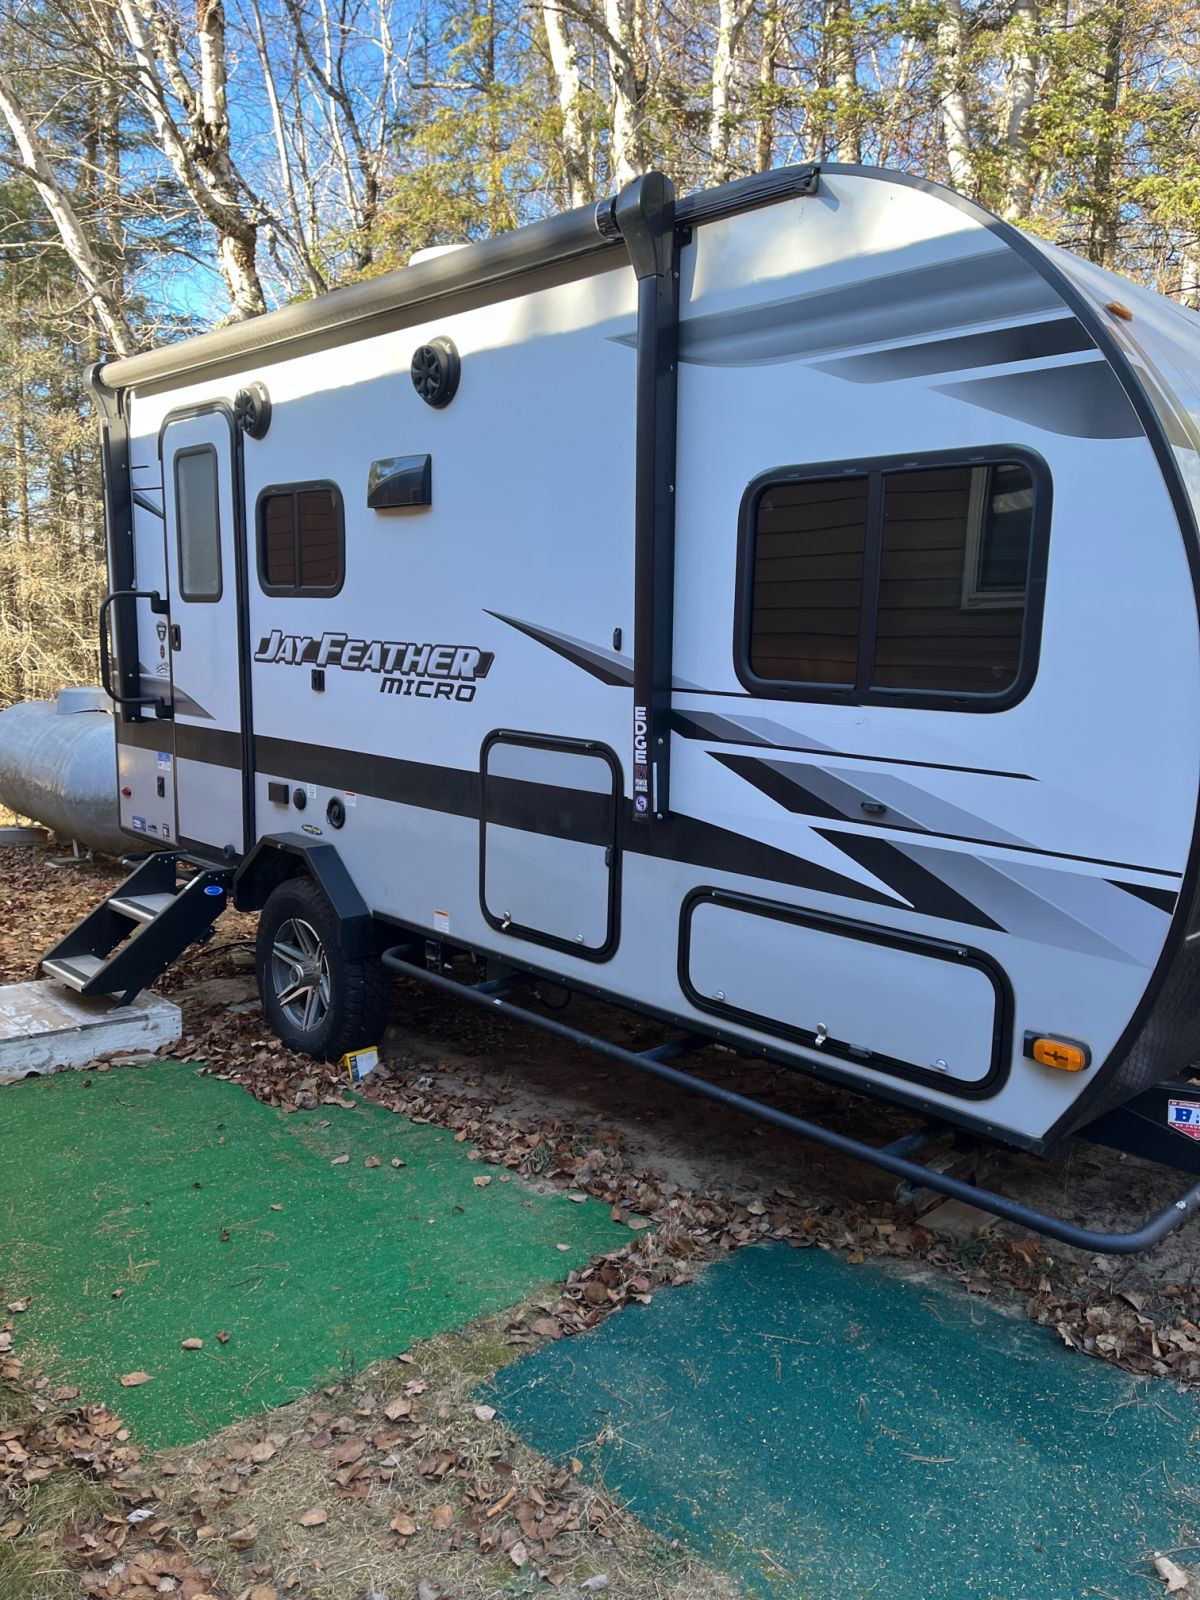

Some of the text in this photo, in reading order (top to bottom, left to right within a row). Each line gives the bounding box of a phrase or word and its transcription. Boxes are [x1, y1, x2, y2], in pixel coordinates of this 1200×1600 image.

[254, 629, 481, 681] JAY FEATHER
[380, 677, 476, 702] MICRO
[634, 706, 647, 764] EDGE
